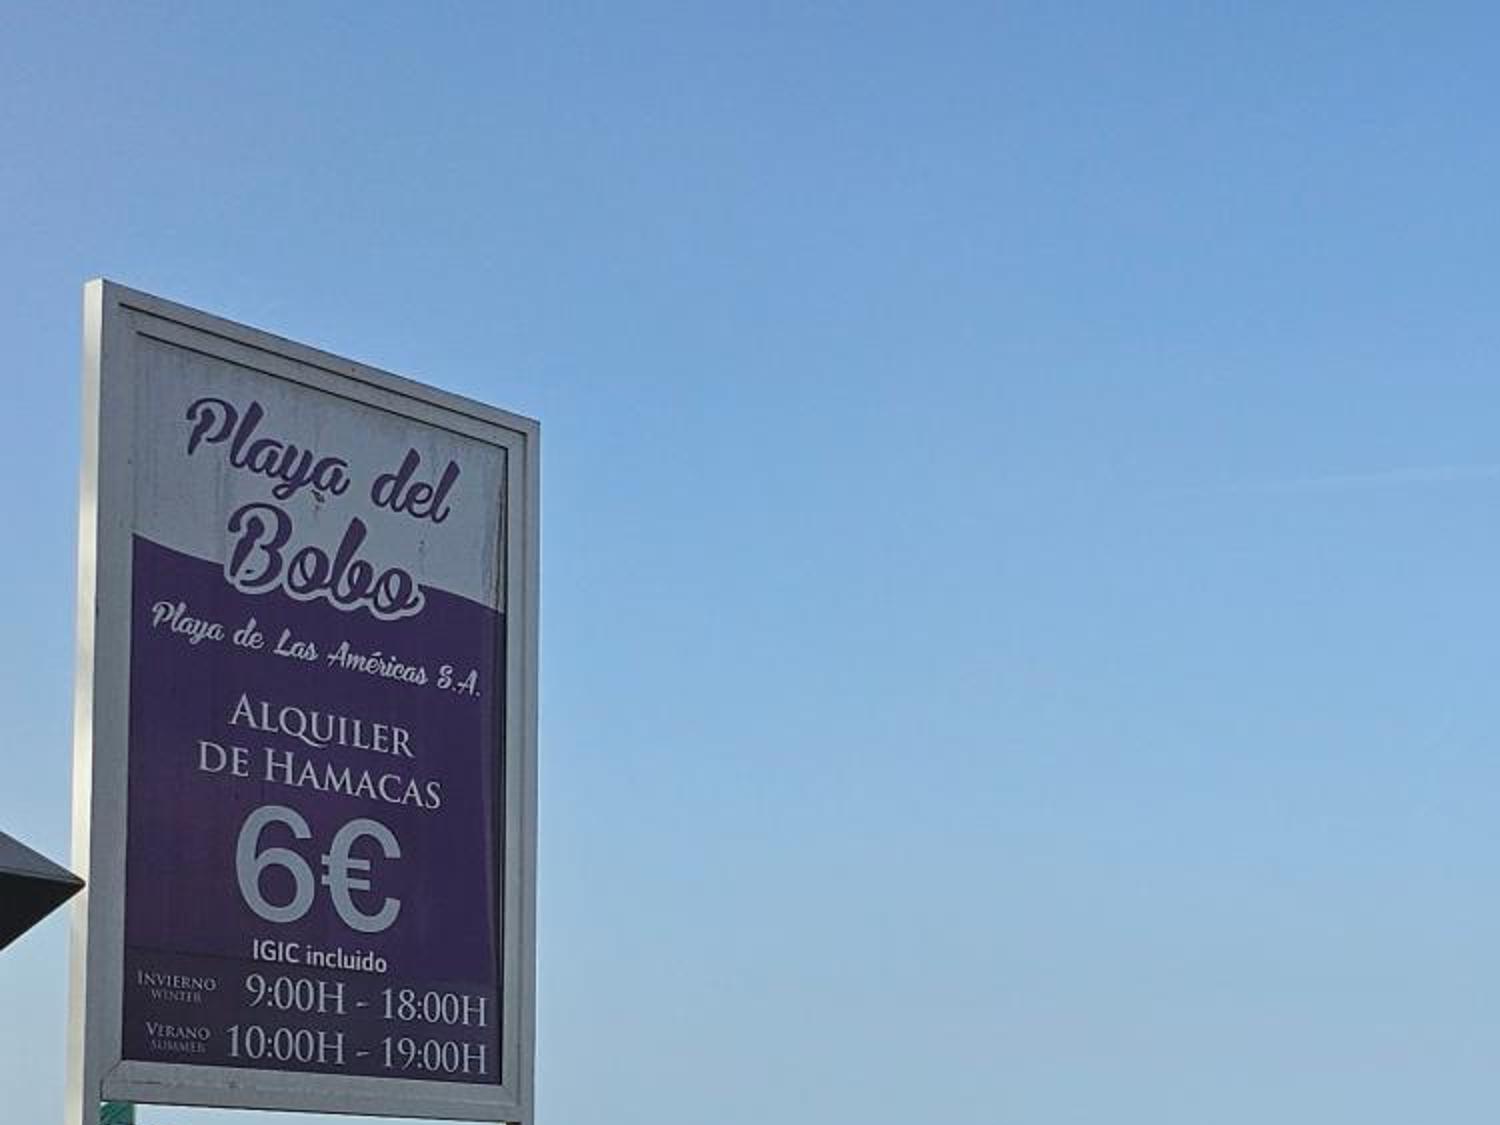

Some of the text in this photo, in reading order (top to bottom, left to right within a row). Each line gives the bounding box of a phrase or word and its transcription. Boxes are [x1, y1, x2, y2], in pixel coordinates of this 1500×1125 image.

[185, 396, 461, 524] Playa del
[227, 501, 425, 615] Bobo
[152, 600, 482, 697] Playa de Las Américas S.A.
[229, 691, 416, 758] ALQUILER
[198, 740, 442, 810] DE HAMACAS
[236, 805, 401, 933] 6€
[253, 939, 388, 975] IGIC incluido
[137, 970, 216, 991] INVIERNO
[246, 973, 346, 1015] 9:00H
[382, 987, 487, 1027] 18:00H
[151, 988, 202, 1003] WINTER
[146, 1022, 211, 1041] VERANO
[226, 1024, 345, 1064] 10:00H
[382, 1037, 487, 1075] 19:00H
